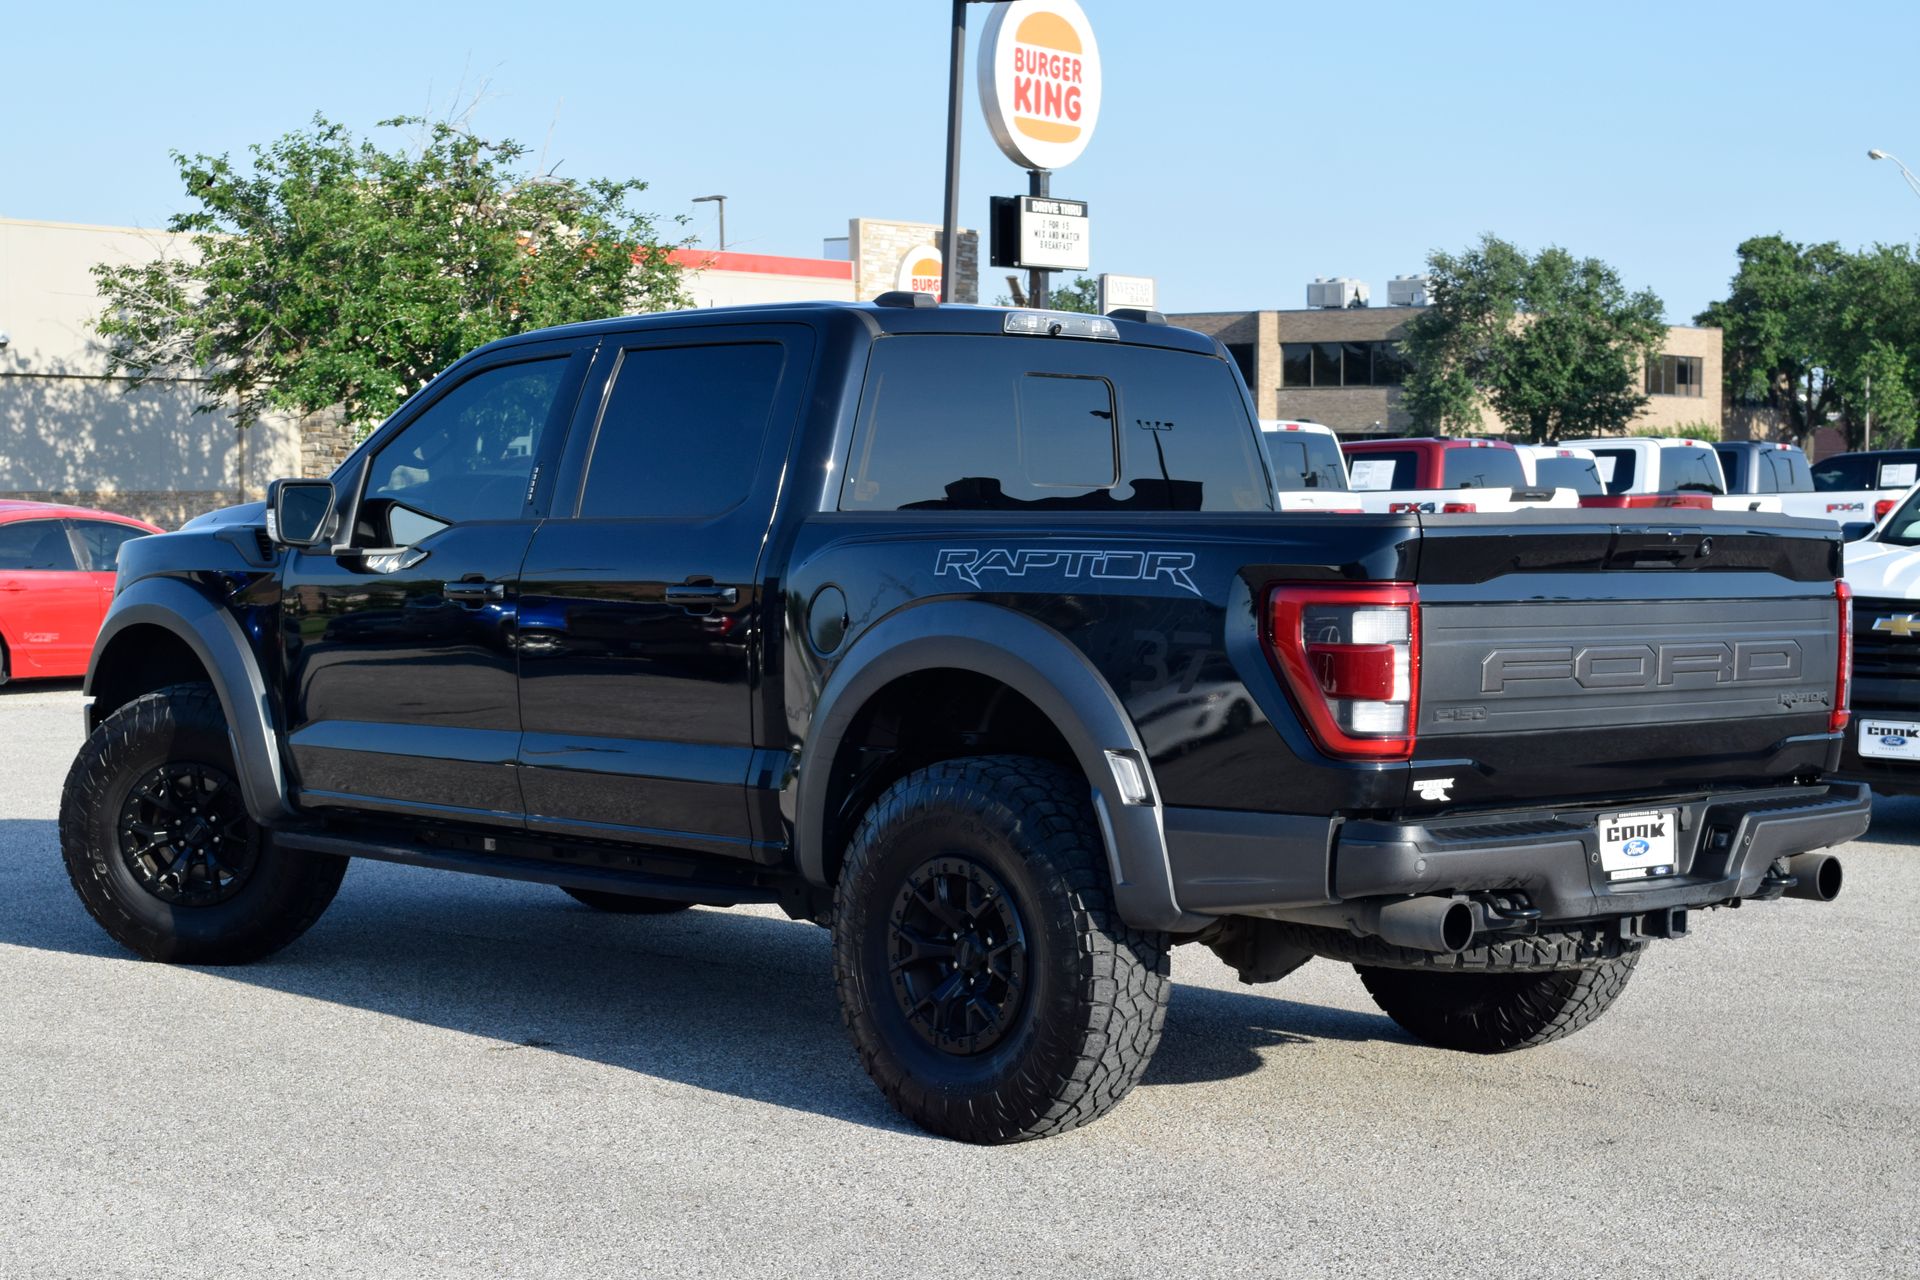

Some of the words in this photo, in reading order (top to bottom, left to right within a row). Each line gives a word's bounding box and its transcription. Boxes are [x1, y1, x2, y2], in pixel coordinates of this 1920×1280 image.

[1015, 47, 1082, 84] BURGER
[1014, 75, 1082, 122] KING
[1032, 200, 1059, 214] DRIVE
[1059, 203, 1082, 217] THRU
[1049, 220, 1059, 230] FOR
[1049, 231, 1059, 240] AND
[1040, 240, 1073, 251] BREAKFAST
[912, 278, 940, 292] BURG
[1389, 502, 1436, 513] FX4
[1826, 503, 1864, 513] FX4
[934, 549, 1202, 597] RAPTOR
[1131, 630, 1212, 694] 37
[1480, 639, 1802, 693] FORD
[1776, 690, 1830, 709] RAPTOR
[1867, 727, 1920, 738] COOK
[1606, 823, 1665, 843] COOK
[1625, 841, 1647, 856] Ford
